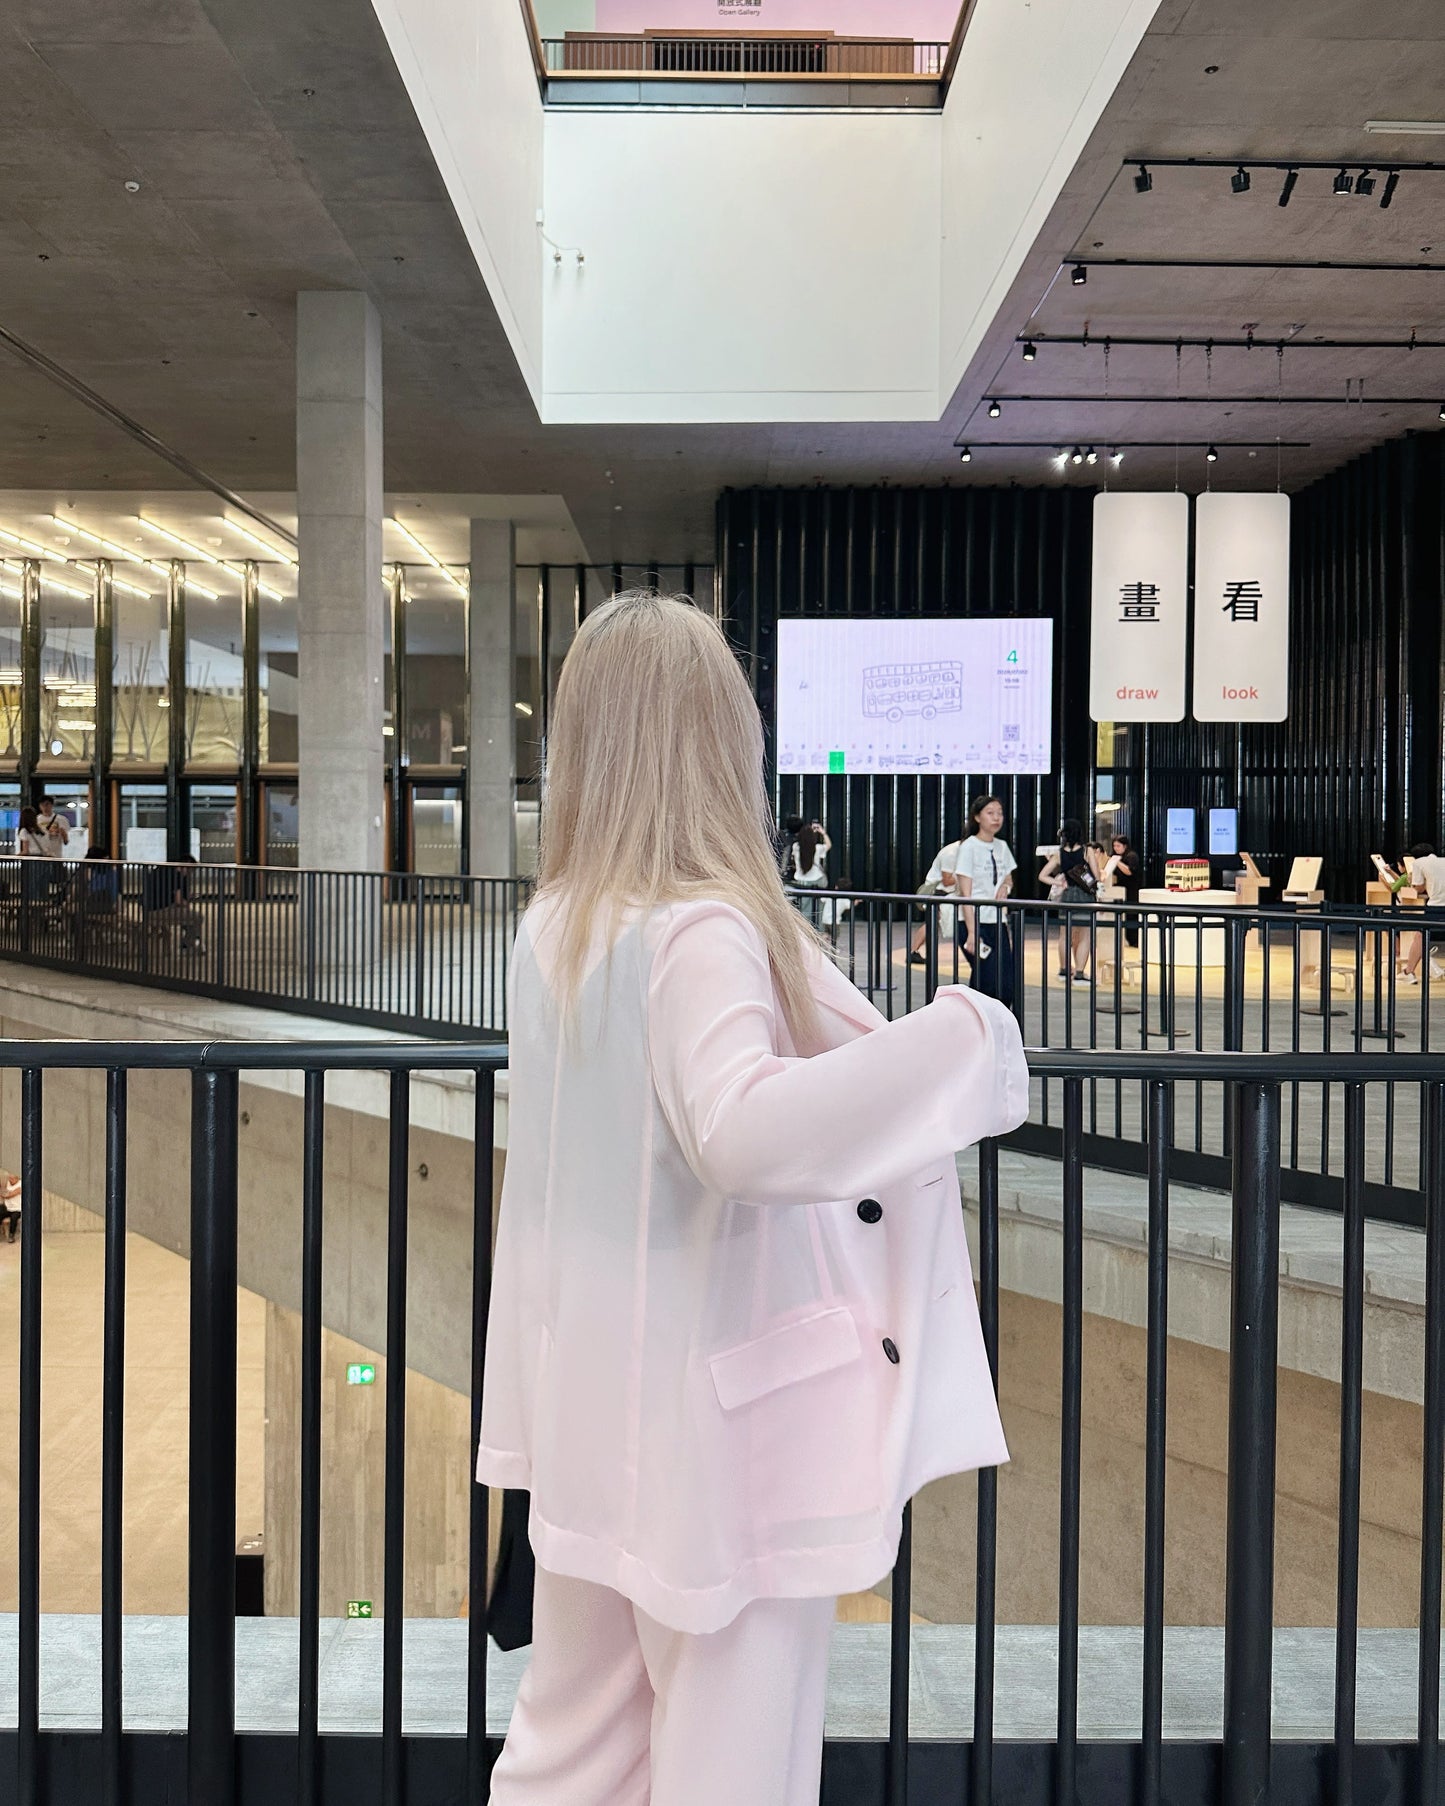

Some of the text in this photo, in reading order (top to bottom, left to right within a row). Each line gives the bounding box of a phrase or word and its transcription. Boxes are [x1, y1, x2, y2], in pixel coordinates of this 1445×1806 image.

[1118, 581, 1160, 622] 畫
[1222, 580, 1262, 622] 看
[1006, 650, 1018, 664] 4
[1116, 686, 1159, 700] draw
[1222, 686, 1258, 700] look
